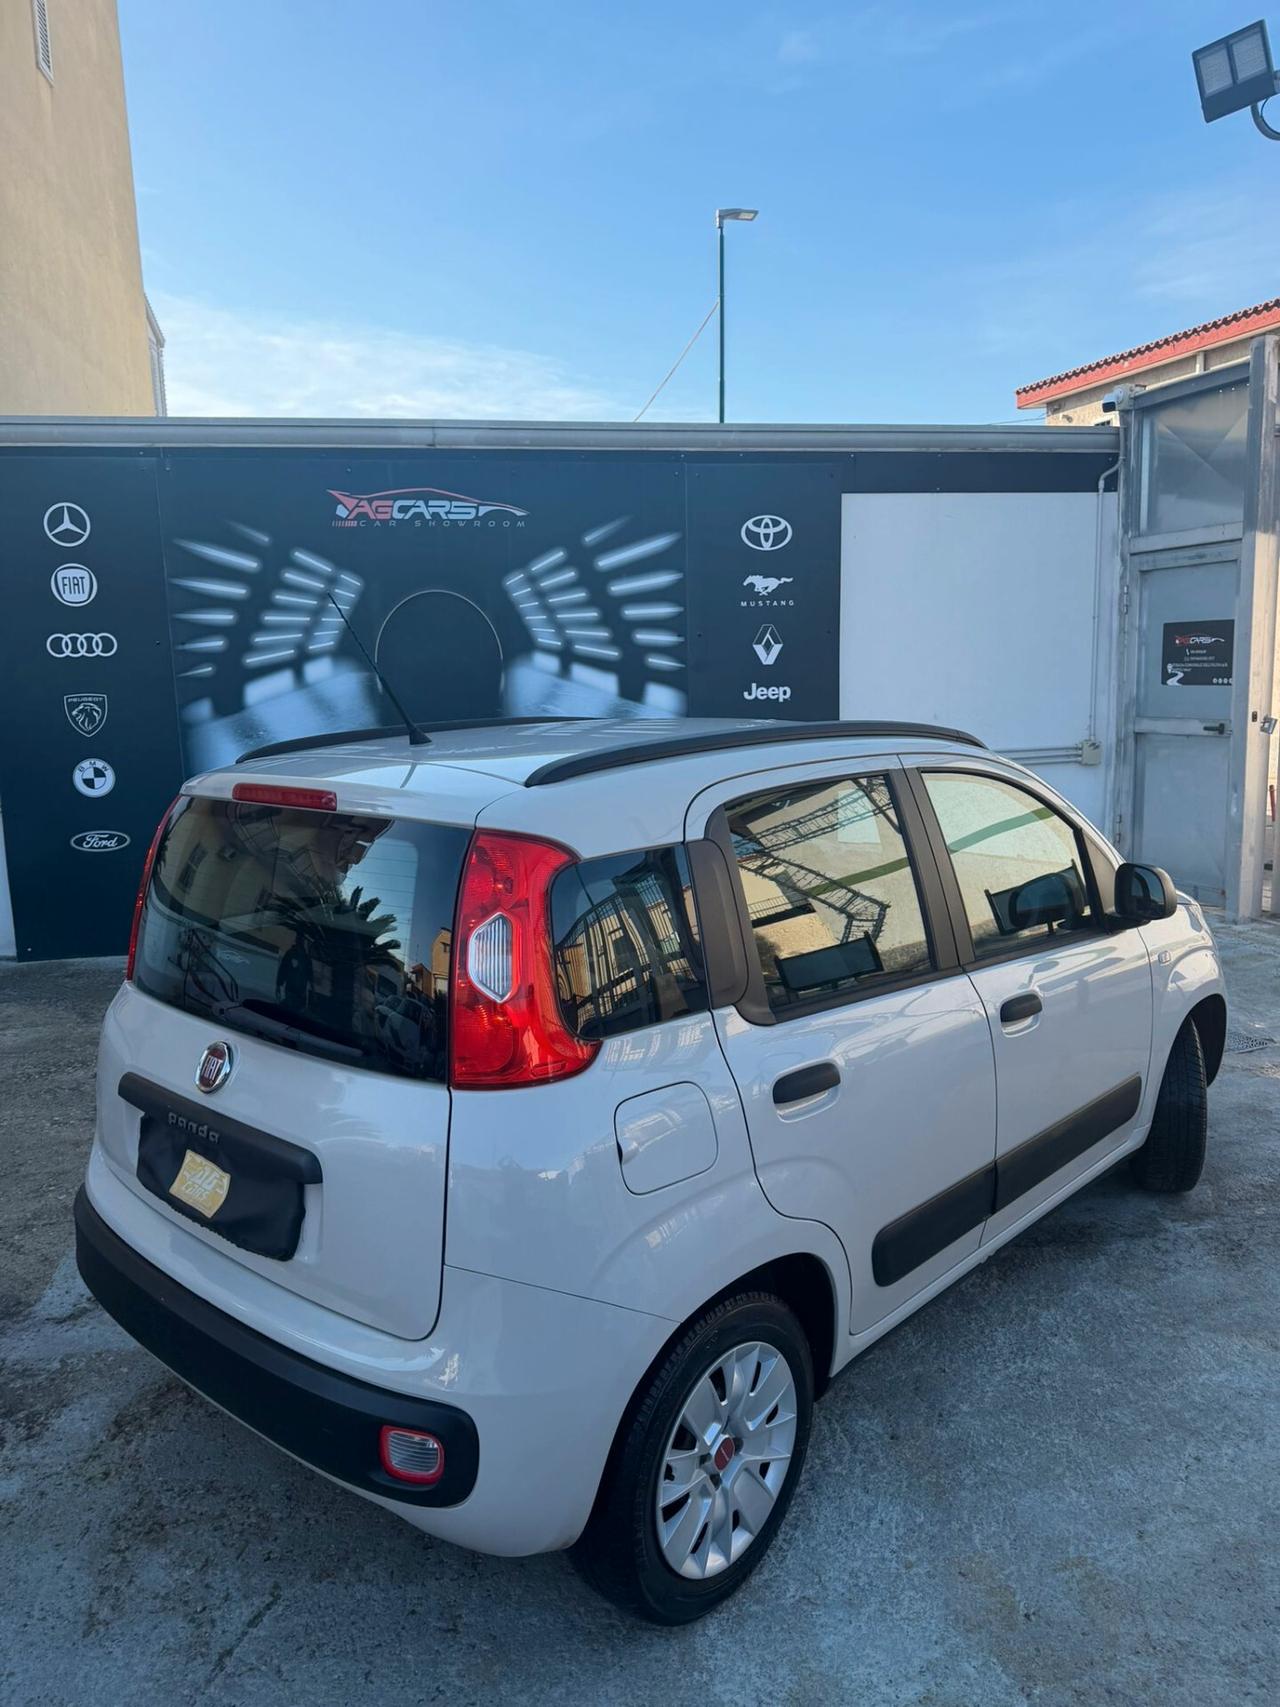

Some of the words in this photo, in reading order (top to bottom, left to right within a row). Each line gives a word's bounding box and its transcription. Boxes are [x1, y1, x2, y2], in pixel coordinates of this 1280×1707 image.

[61, 576, 85, 595] FIAT
[743, 683, 791, 702] Jeep
[78, 761, 109, 773] BMW
[82, 833, 118, 848] Ford
[201, 1055, 224, 1081] FIAT
[168, 1111, 220, 1143] panda
